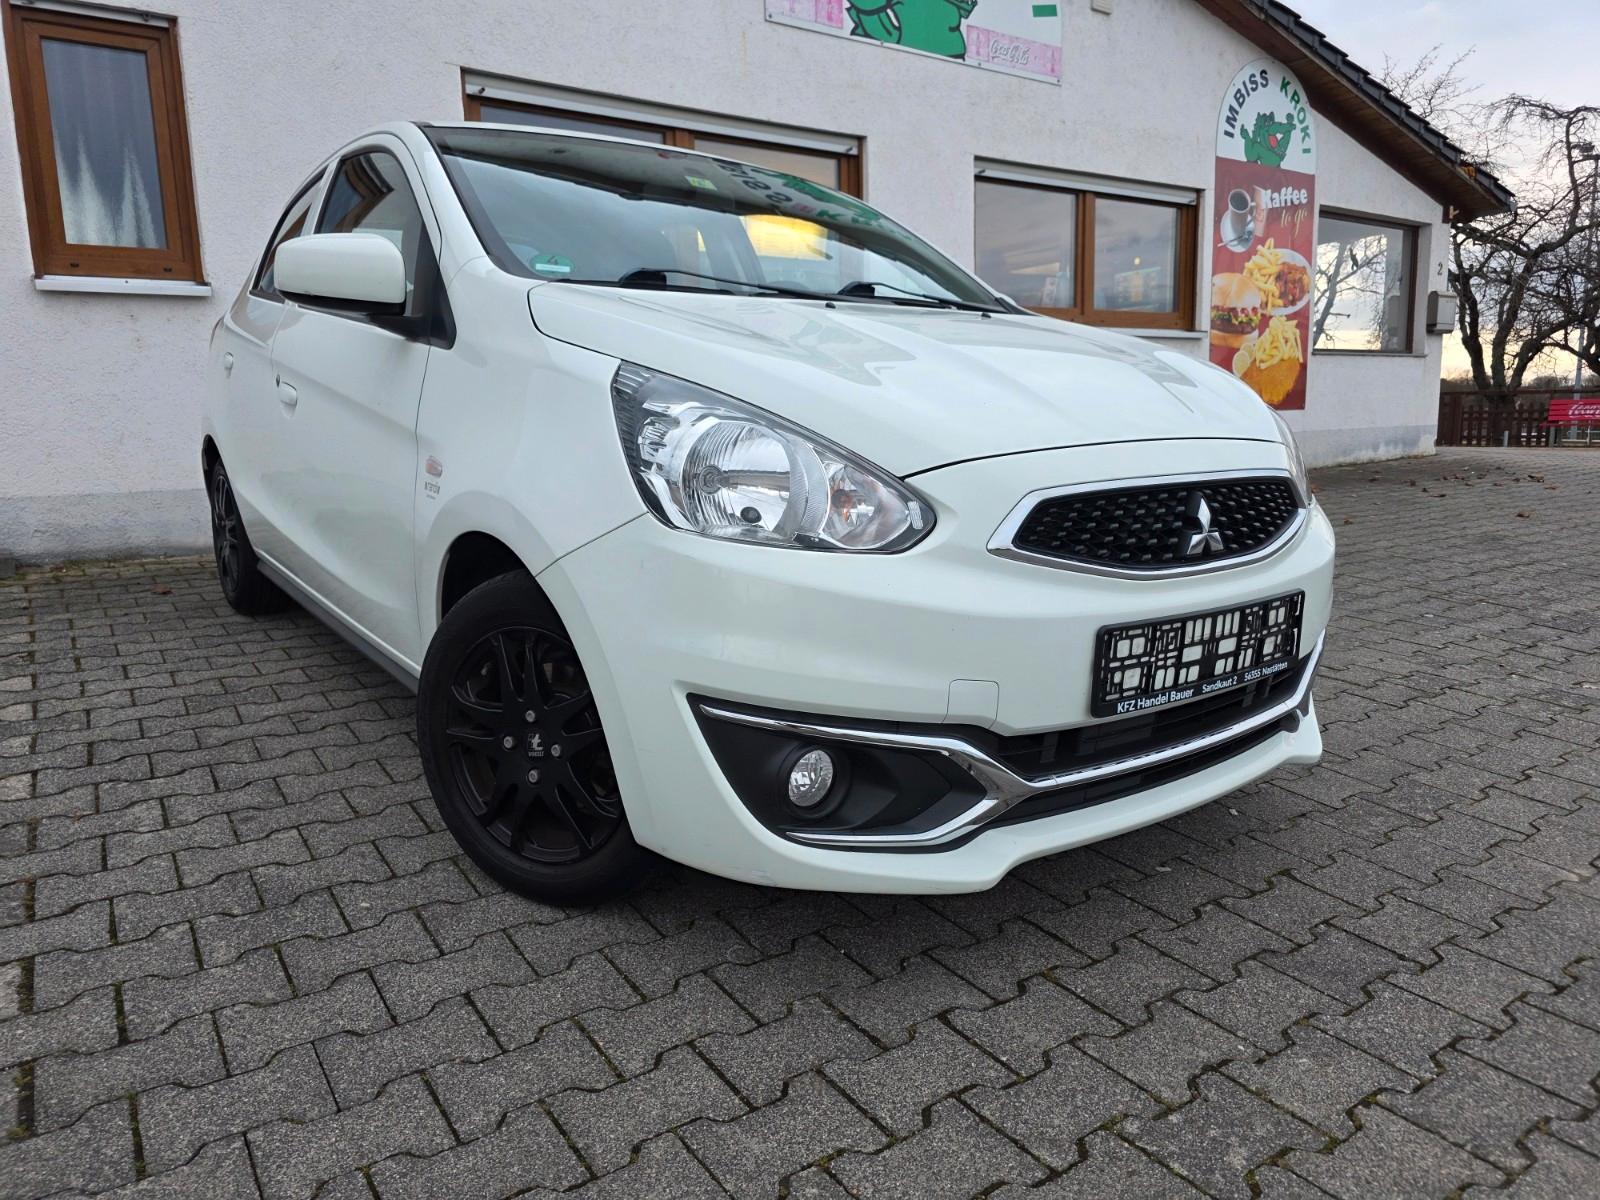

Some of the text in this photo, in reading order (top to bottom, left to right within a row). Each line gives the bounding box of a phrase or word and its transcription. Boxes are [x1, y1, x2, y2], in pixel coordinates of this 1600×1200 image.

[1223, 68, 1312, 154] IMBISS KROKI
[1261, 186, 1308, 208] Kaffee
[1437, 261, 1443, 276] 2
[1117, 700, 1136, 714] KFZ
[1137, 694, 1169, 710] Handel
[1170, 689, 1194, 702] Bauer
[1232, 676, 1238, 685] 2
